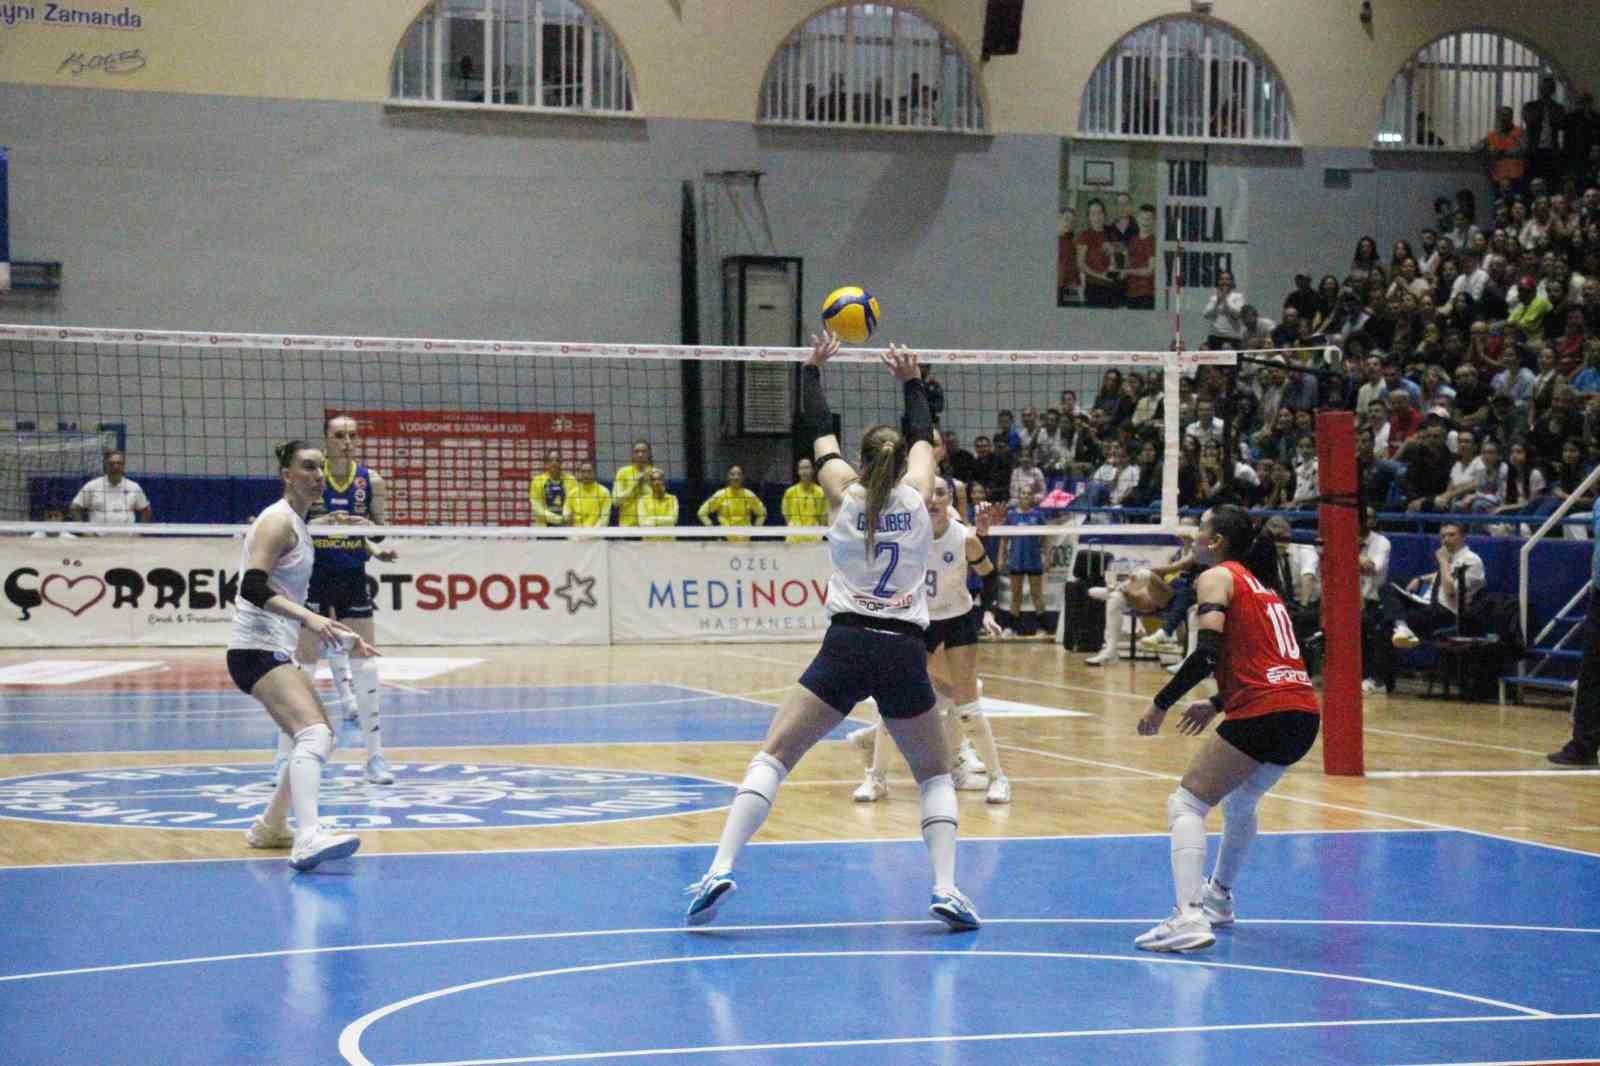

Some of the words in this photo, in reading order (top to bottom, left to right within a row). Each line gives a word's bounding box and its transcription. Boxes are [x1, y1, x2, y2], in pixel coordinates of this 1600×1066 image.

[0, 4, 35, 24] ynı
[44, 3, 142, 27] Zamanda
[857, 512, 911, 532] GUBER
[729, 556, 781, 572] ÖZEL
[873, 541, 899, 598] 2
[925, 569, 937, 598] 9
[1267, 603, 1300, 659] 10
